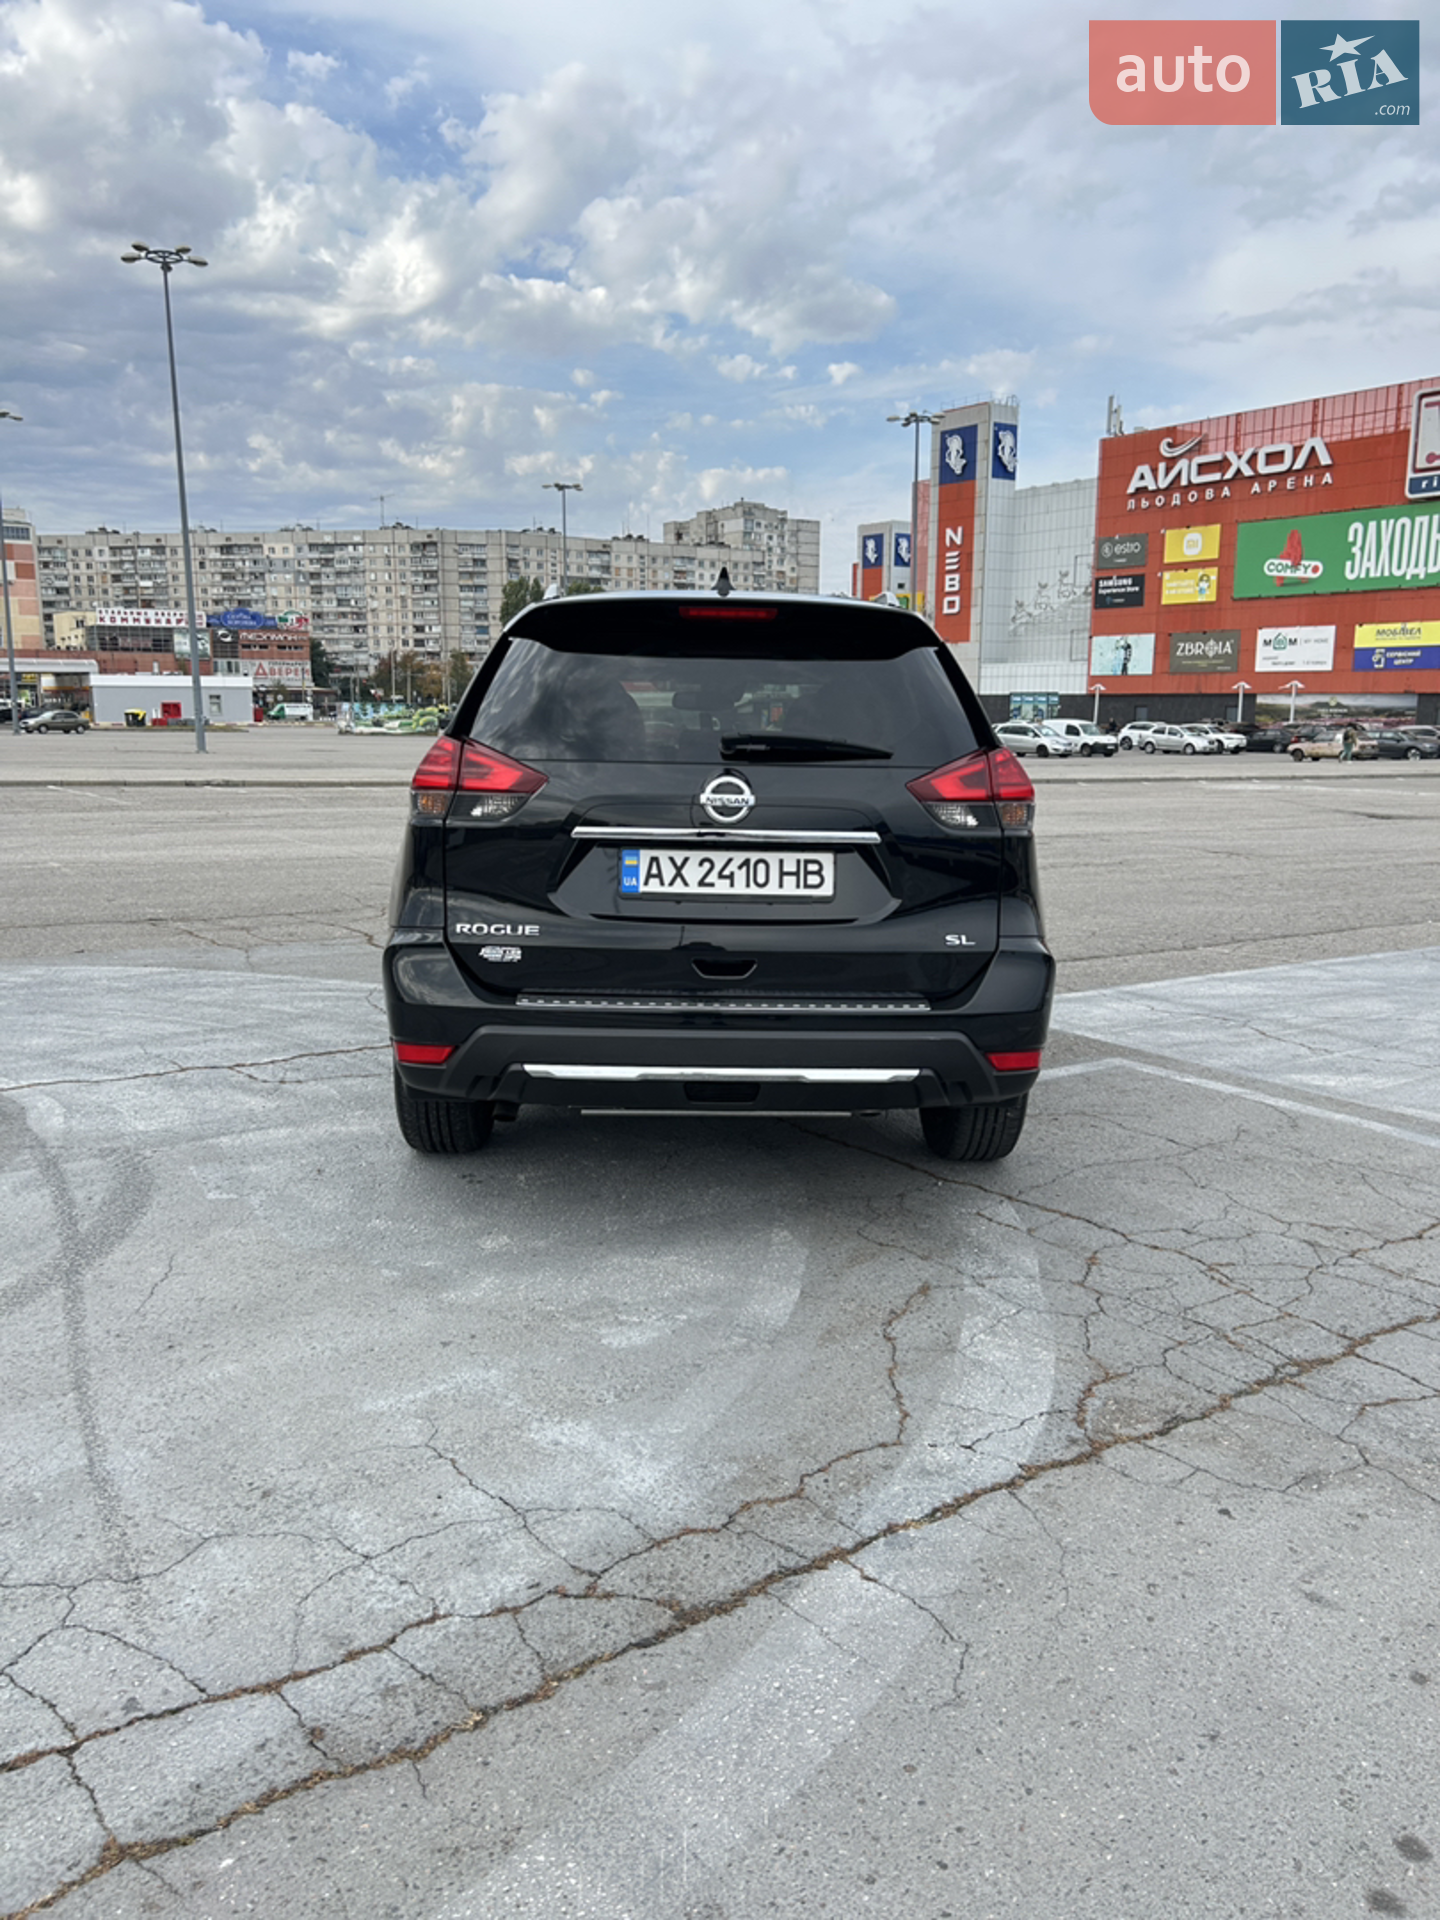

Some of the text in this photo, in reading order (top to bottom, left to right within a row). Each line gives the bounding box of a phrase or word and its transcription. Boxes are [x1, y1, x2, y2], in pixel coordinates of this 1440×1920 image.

[1127, 433, 1333, 494] АЙСХОЛ
[1127, 473, 1333, 511] ЛЬОДОВА АРЕНА
[1114, 542, 1141, 555] estro
[1266, 561, 1312, 575] COMFY
[1098, 577, 1133, 588] SAMSUNG
[1098, 585, 1140, 596] Experience Store
[705, 796, 750, 806] NISSAN
[643, 856, 825, 889] AX 2410 HB
[623, 877, 637, 886] UA
[455, 923, 540, 936] ROGUE
[945, 934, 976, 946] SL
